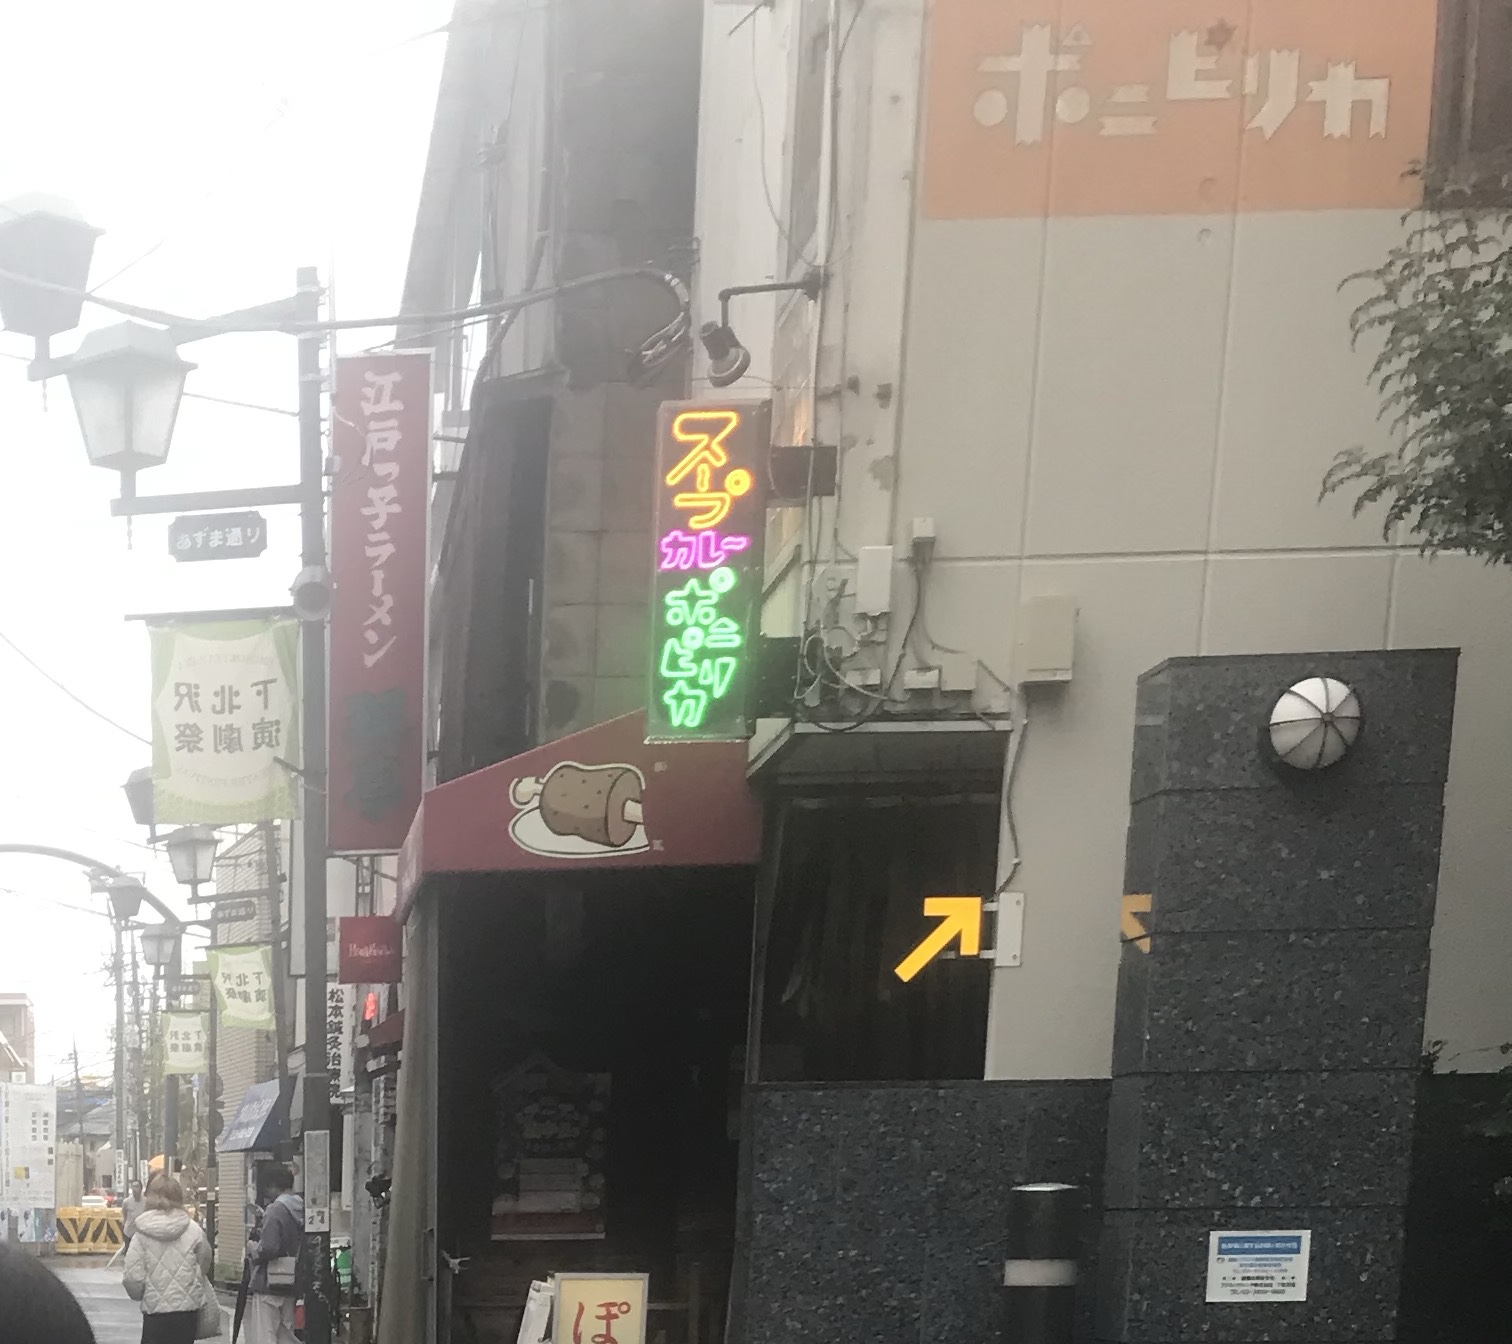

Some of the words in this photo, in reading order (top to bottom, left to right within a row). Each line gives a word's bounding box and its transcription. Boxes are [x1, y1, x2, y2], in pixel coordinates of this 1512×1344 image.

[176, 526, 261, 550] あずま通り
[359, 369, 405, 668] 江戸っ子ラーメン
